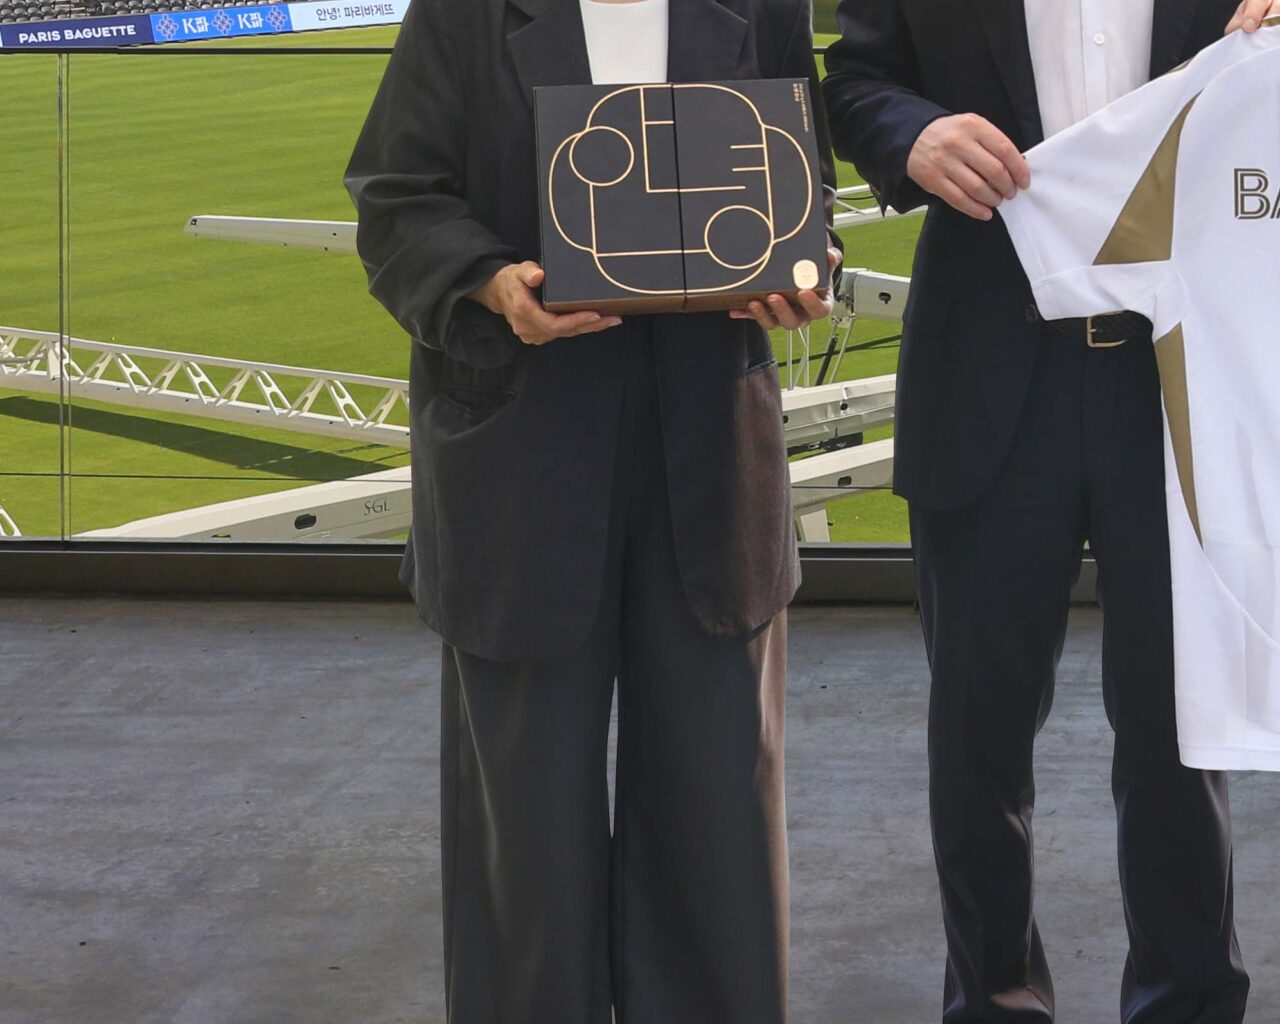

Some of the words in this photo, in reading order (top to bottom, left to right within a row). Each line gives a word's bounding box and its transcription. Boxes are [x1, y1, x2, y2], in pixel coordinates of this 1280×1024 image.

[315, 7, 342, 21] 안녕!
[344, 3, 395, 18] 파리바게뜨
[18, 30, 61, 44] PARIS
[63, 24, 137, 41] BAGUETTE
